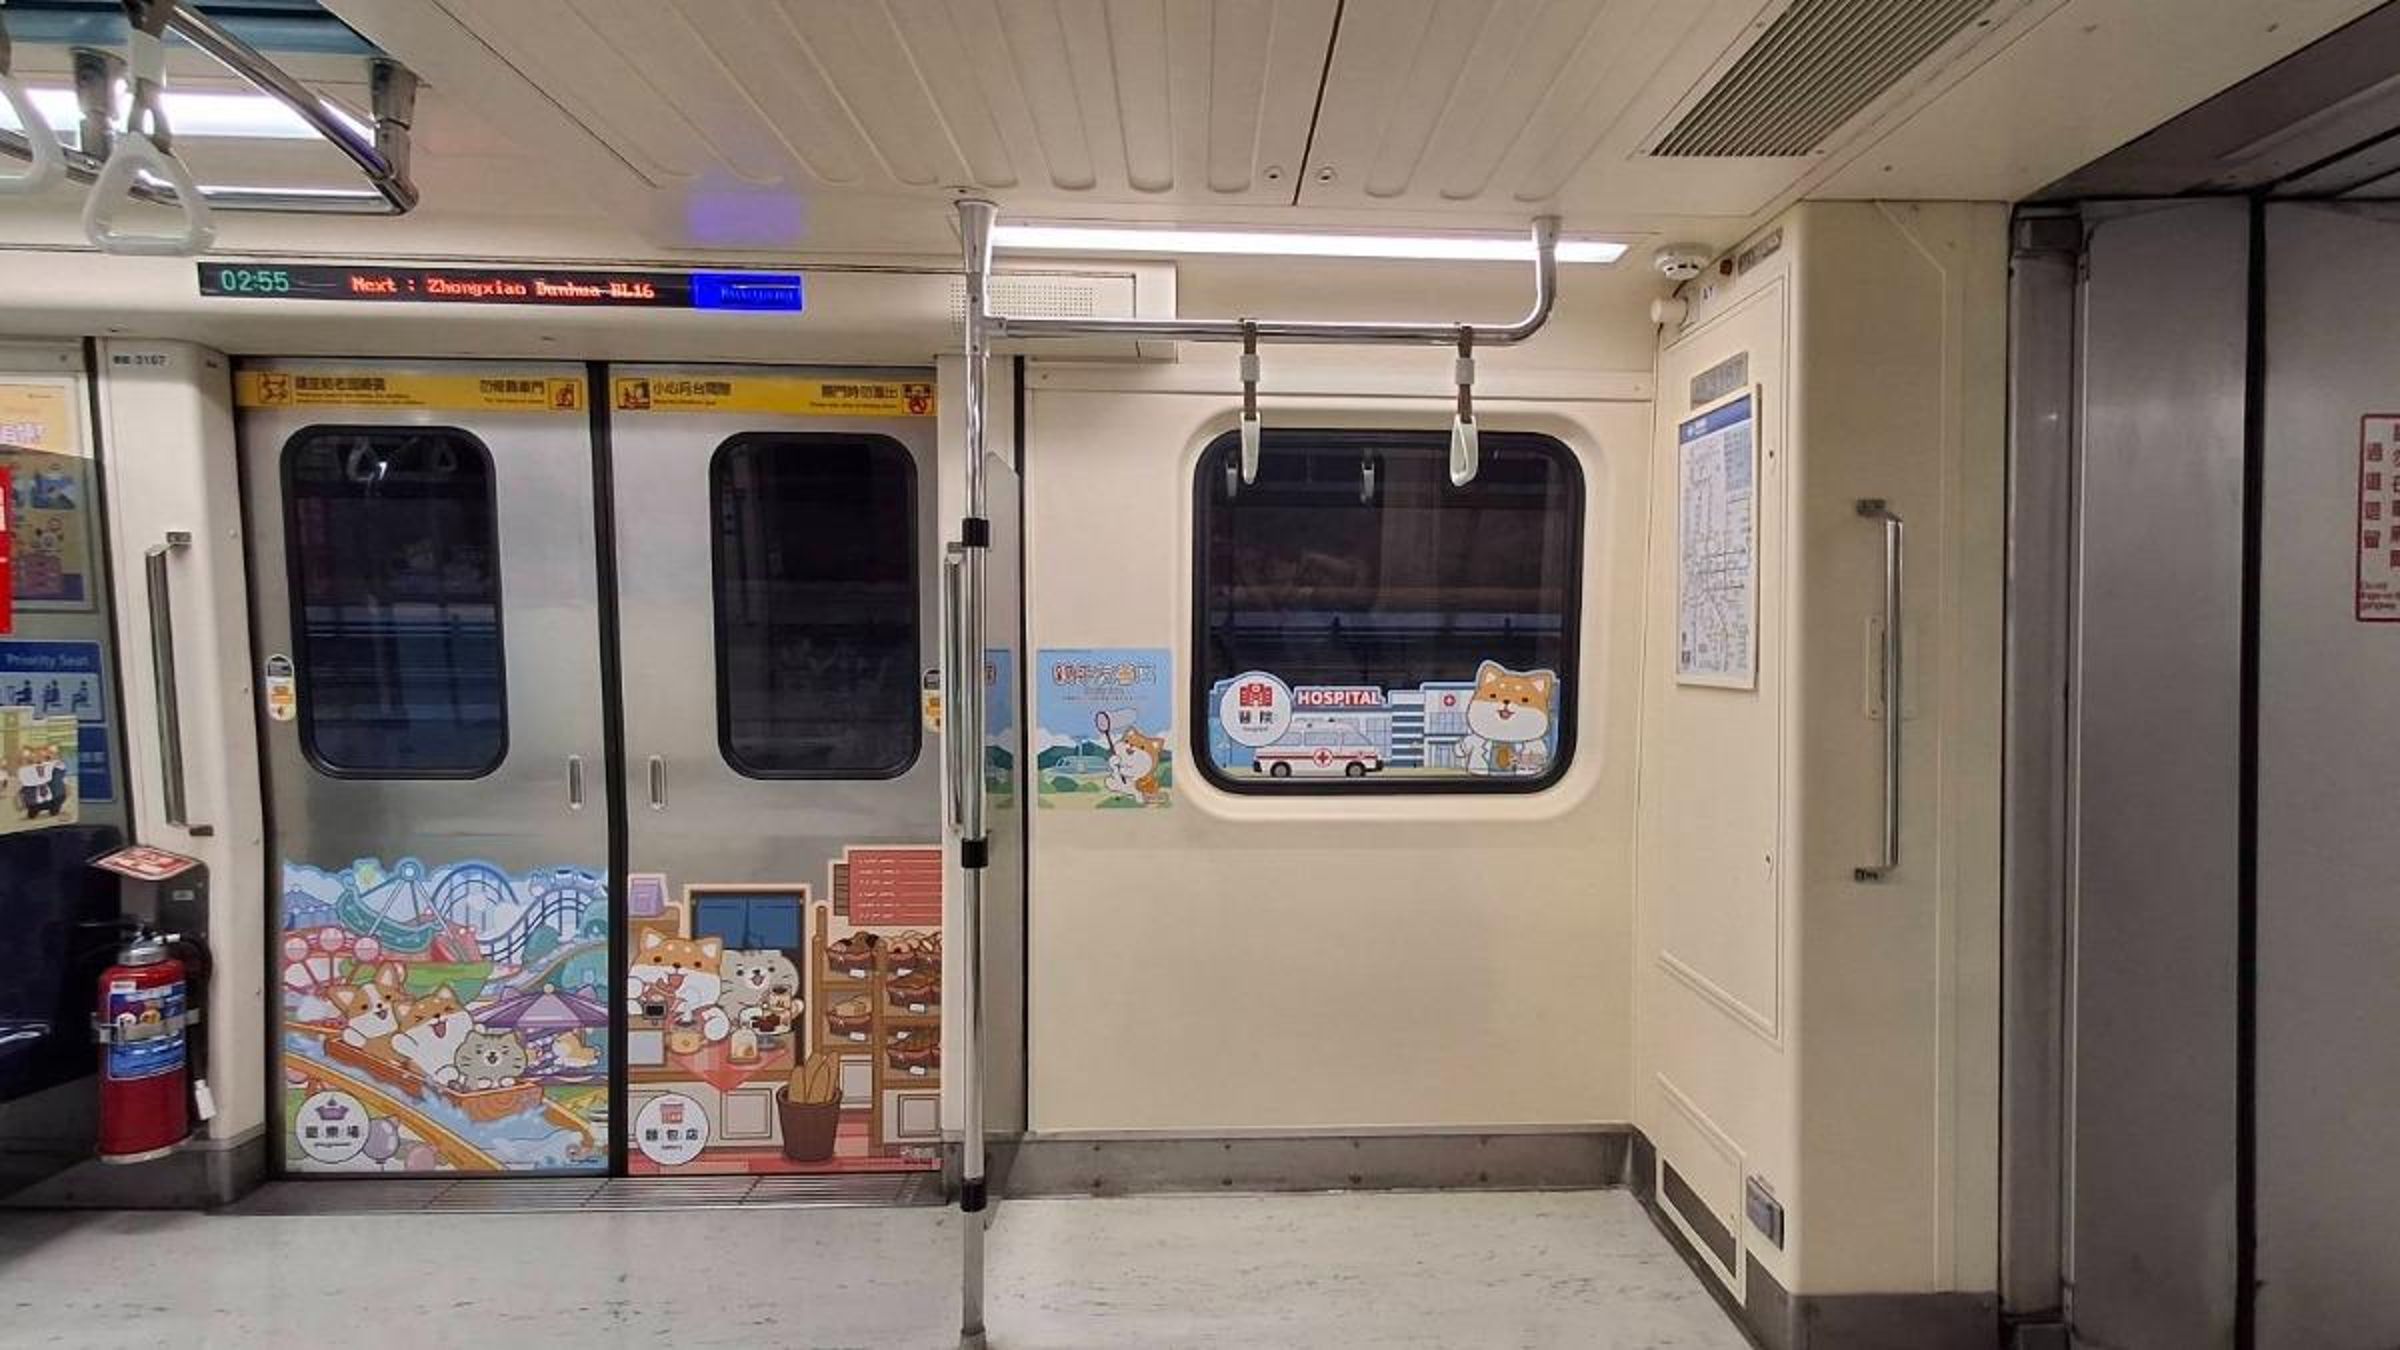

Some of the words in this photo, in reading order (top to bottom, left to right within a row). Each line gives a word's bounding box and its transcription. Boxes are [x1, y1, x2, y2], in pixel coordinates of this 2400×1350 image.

[220, 270, 289, 292] 02:55
[351, 277, 398, 294] Next
[426, 278, 527, 297] Zhongxiao
[610, 282, 655, 299] BL16
[1298, 690, 1381, 705] HOSPITAL
[1239, 710, 1274, 724] 醫院
[645, 1128, 699, 1141] 麵包店
